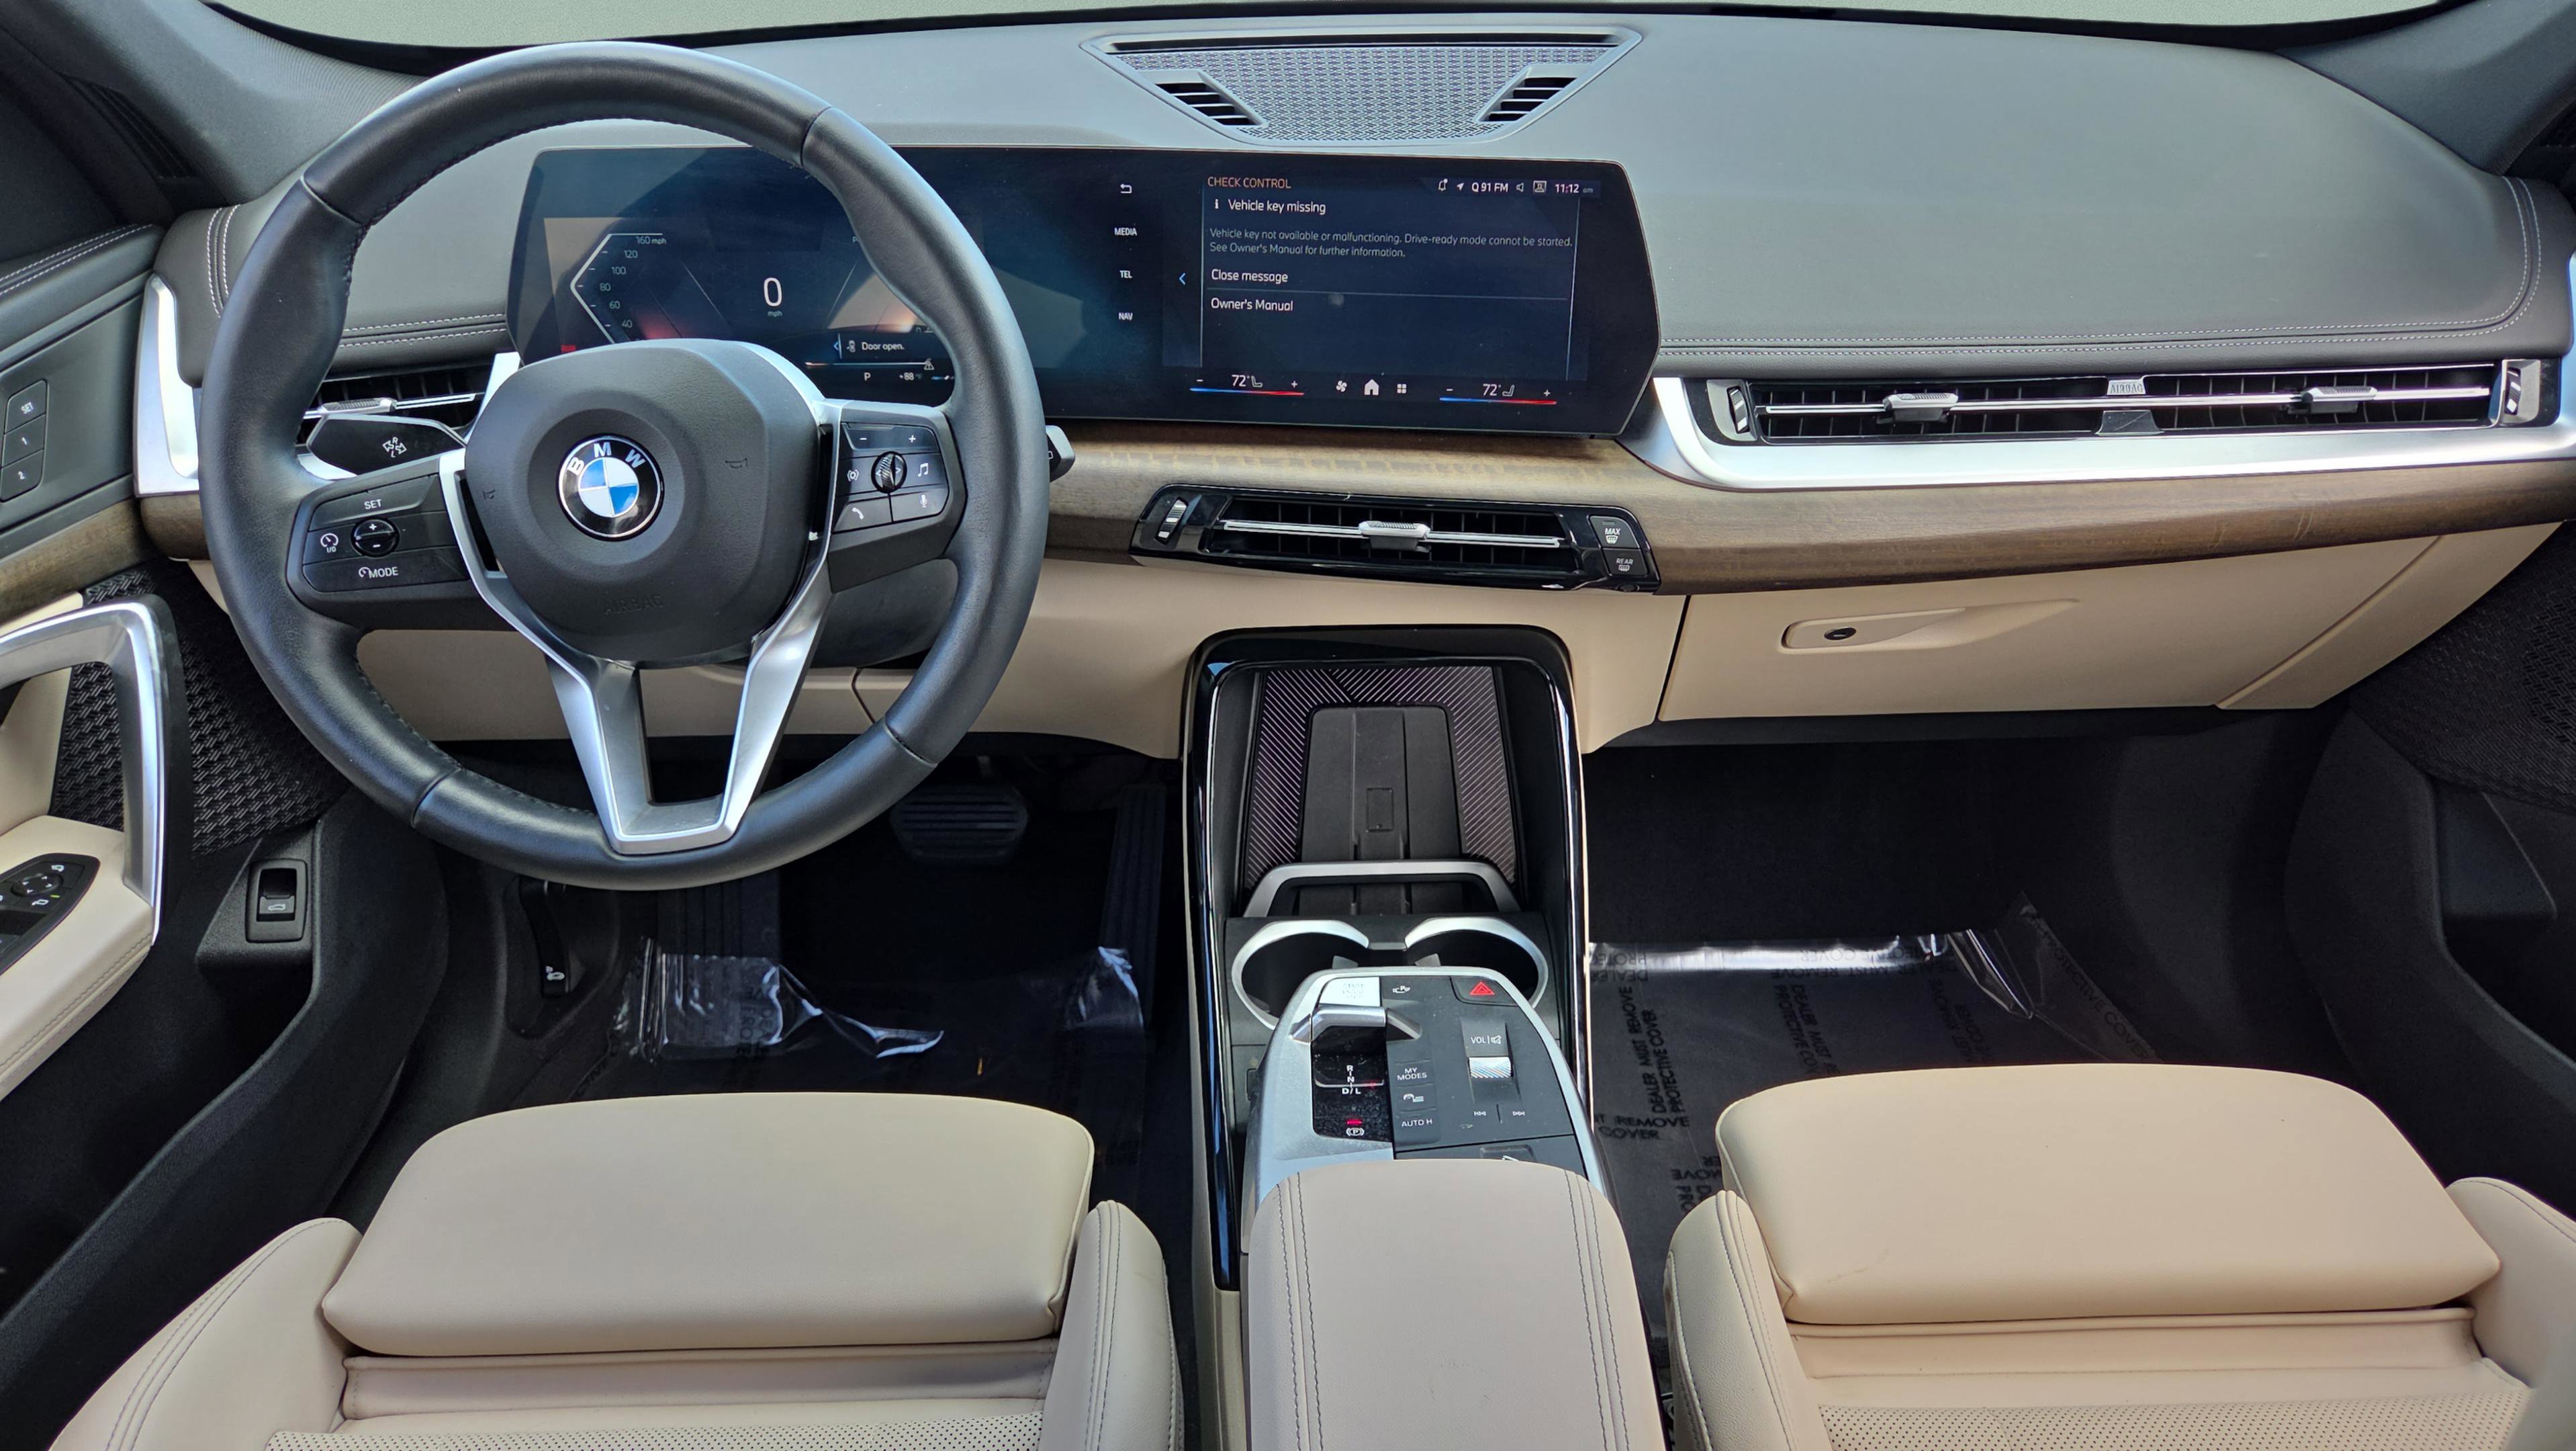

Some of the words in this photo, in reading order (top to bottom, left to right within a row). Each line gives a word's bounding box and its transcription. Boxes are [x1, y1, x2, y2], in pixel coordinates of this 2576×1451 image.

[1207, 176, 1242, 188] CHECK
[1243, 177, 1291, 189] CONTROL
[1481, 182, 1491, 192] 91
[1494, 183, 1509, 193] FM
[1555, 183, 1579, 193] 11:12
[1228, 200, 1265, 212] Vehicle
[1267, 200, 1284, 214] key
[1286, 201, 1326, 215] missing
[1114, 227, 1138, 236] MEDIA
[635, 236, 651, 245] 160
[1209, 228, 1242, 240] Vehicle
[1244, 229, 1260, 242] key
[1262, 230, 1277, 240] not
[1279, 229, 1320, 241] available
[1332, 231, 1403, 245] malfunctioning.
[1404, 234, 1458, 247] Drive-ready
[1459, 234, 1487, 246] mode
[1488, 236, 1521, 247] cannot
[1522, 236, 1536, 247] be
[1538, 236, 1573, 247] started.
[623, 249, 638, 259] 120
[1209, 243, 1228, 253] See
[1230, 243, 1268, 253] Owner's
[1269, 244, 1303, 255] Manual
[1304, 245, 1316, 255] for
[1318, 245, 1350, 256] further
[1351, 247, 1406, 257] information.
[611, 266, 627, 275] 100
[1119, 270, 1133, 279] TEL
[1211, 269, 1240, 283] Close
[1241, 272, 1289, 285] message
[599, 282, 612, 292] 80
[764, 277, 783, 307] 0
[609, 300, 621, 310] 60
[1211, 297, 1253, 312] Owner's
[1255, 299, 1294, 312] Manual
[767, 310, 783, 318] mph
[1118, 312, 1134, 321] NAV
[621, 319, 633, 328] 40
[861, 341, 880, 351] Door
[882, 343, 905, 352] open.
[864, 372, 872, 382] P
[2110, 384, 2144, 394] AIRBAG
[21, 402, 34, 414] SET
[21, 437, 28, 446] 1
[566, 441, 646, 476] BMW
[17, 471, 26, 480] 2
[364, 499, 382, 510] SET
[1604, 528, 1622, 536] MAX
[1616, 558, 1634, 566] REAR
[369, 567, 399, 578] MODE
[1618, 985, 1642, 1035] REMOVE
[1641, 1009, 1665, 1046] COVER
[1471, 1037, 1486, 1045] VOL
[1632, 1039, 1653, 1067] MUST
[1397, 1073, 1428, 1081] MODES
[1653, 1046, 1687, 1114] PROTECTIVE
[1643, 1072, 1667, 1114] DEALER
[1614, 1114, 1690, 1128] REMOVE
[1598, 1126, 1659, 1140] COVER
